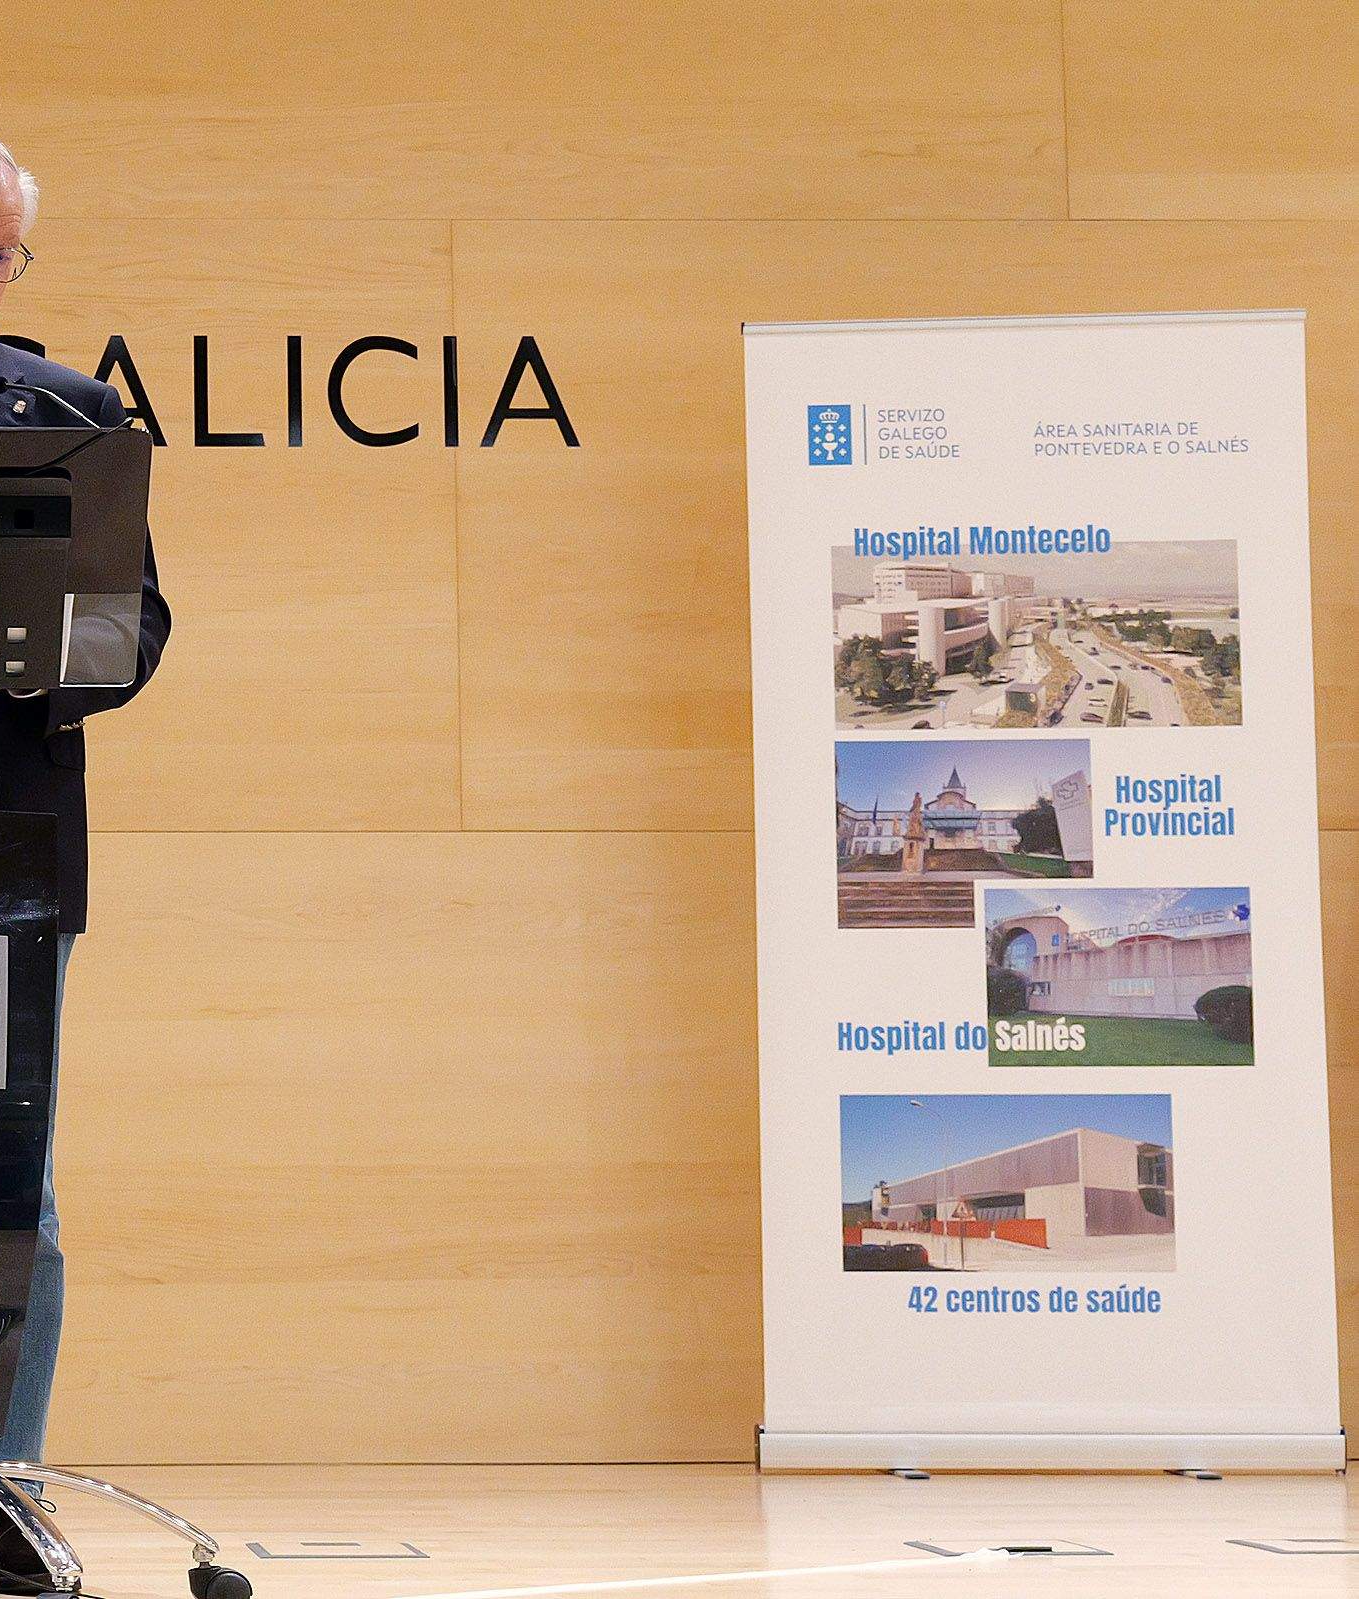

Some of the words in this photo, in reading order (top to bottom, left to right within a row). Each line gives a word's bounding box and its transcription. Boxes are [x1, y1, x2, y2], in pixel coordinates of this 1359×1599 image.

[877, 408, 945, 423] SERVIZO
[878, 426, 948, 441] GALEGO
[1034, 420, 1078, 438] ÁREA
[1083, 422, 1172, 437] SANITARIA
[1177, 422, 1199, 436] DE
[879, 446, 900, 459] DE
[905, 441, 961, 459] SAÚDE
[1034, 441, 1148, 457] PONTEVEDRA
[1153, 441, 1162, 455] E
[1167, 440, 1180, 455] O
[1186, 435, 1250, 454] SALNÉS
[853, 526, 961, 561] Hospital
[969, 524, 1111, 555] Montecelo
[1115, 773, 1222, 810] Hospital
[1104, 807, 1235, 837] Provincial
[837, 1020, 945, 1056] Hospital
[955, 1021, 987, 1051] do
[994, 1016, 1087, 1053] Salnés
[908, 1285, 939, 1313] 42
[945, 1285, 1041, 1313] centros
[1048, 1285, 1079, 1313] de
[1086, 1283, 1162, 1313] saúde
